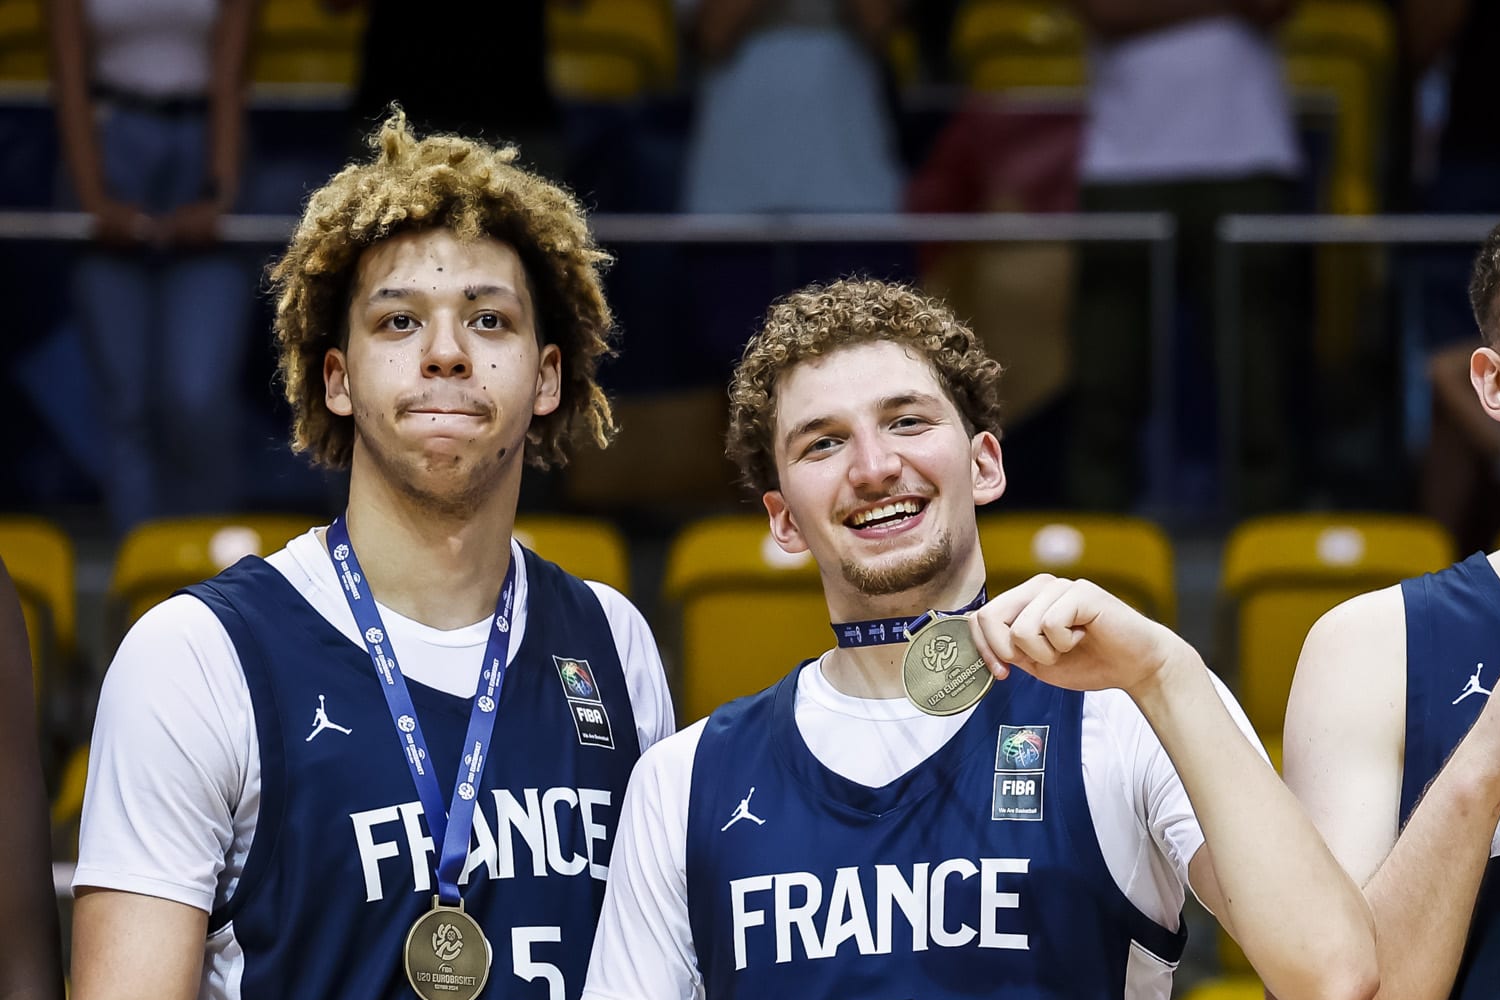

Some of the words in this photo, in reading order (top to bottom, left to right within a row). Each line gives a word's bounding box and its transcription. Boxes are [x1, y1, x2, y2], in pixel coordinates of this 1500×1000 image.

[928, 690, 945, 706] U20
[943, 657, 986, 694] EUROBASKE
[576, 706, 603, 725] FIBA
[1002, 780, 1036, 796] FIBA
[729, 858, 1031, 971] FRANCE
[416, 971, 431, 982] U20
[432, 973, 476, 986] EUROBASKET
